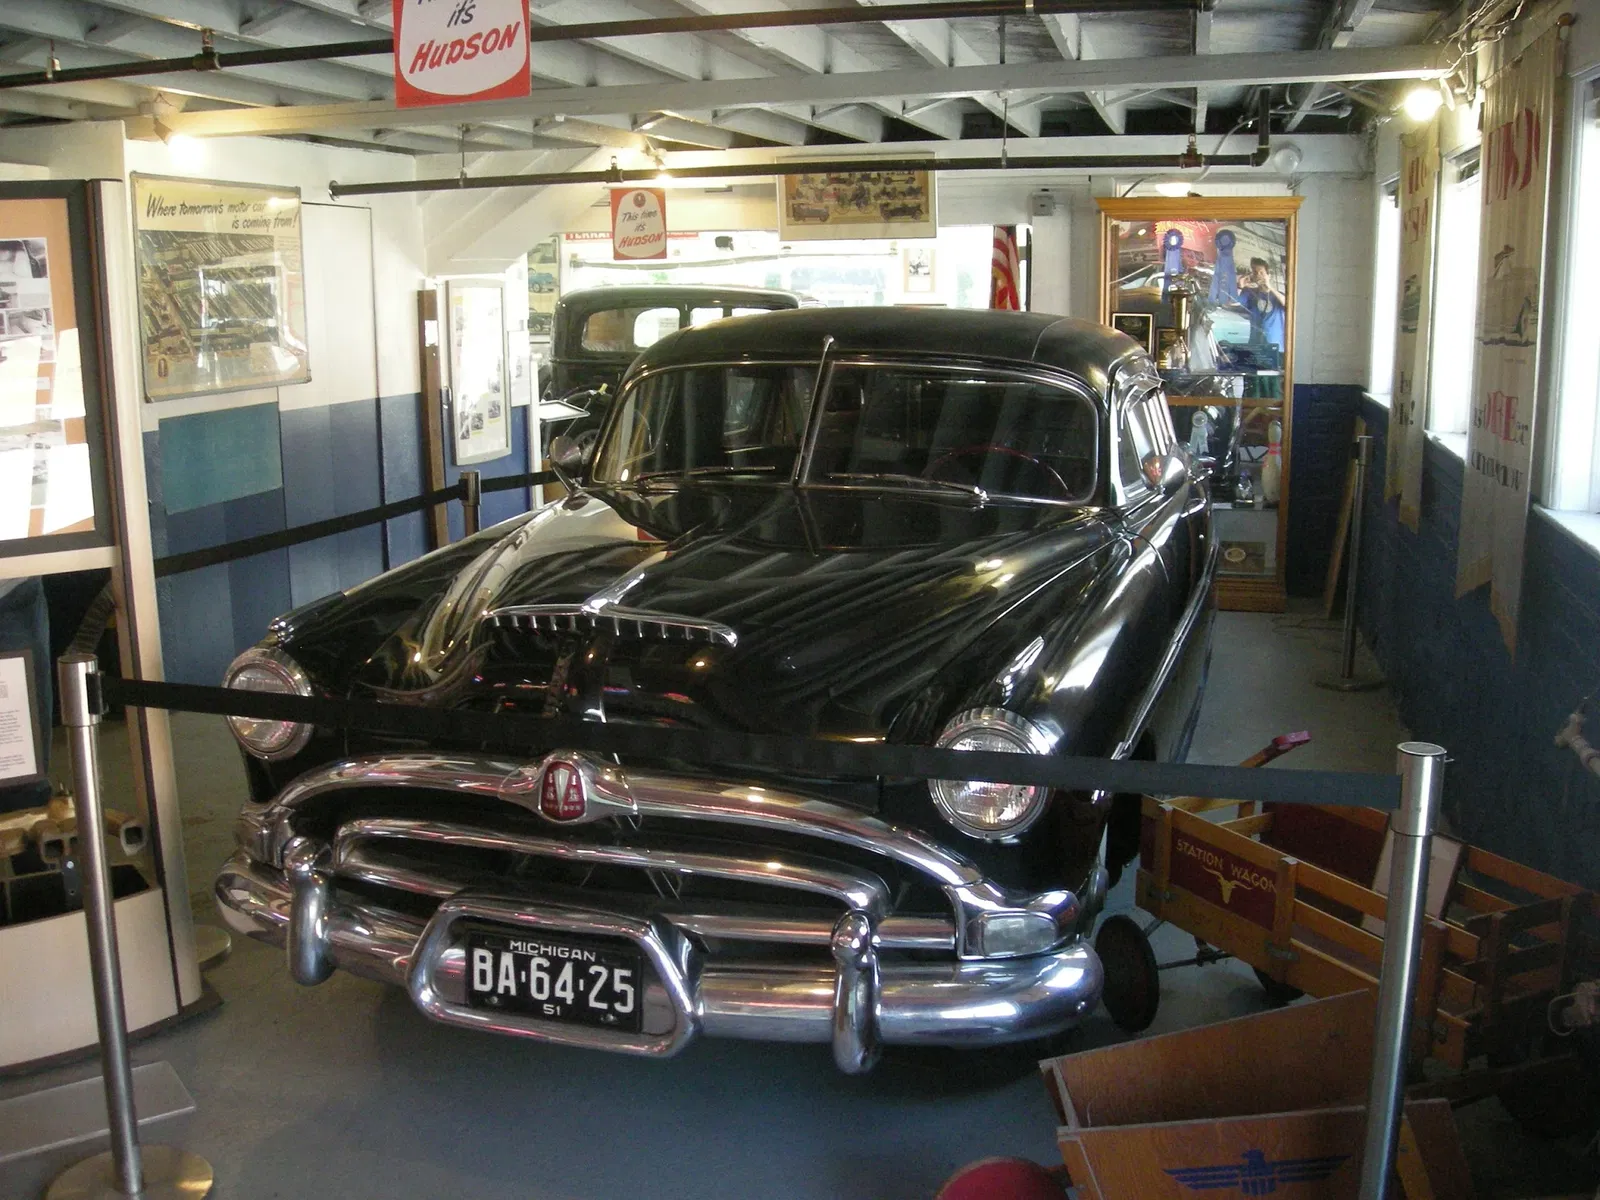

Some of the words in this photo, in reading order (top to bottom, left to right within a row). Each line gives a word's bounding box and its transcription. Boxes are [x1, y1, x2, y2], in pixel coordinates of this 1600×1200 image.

[409, 21, 521, 74] HUDSON
[146, 193, 177, 218] Where
[179, 199, 224, 217] tomorrow's
[227, 200, 251, 214] motor
[622, 212, 638, 222] This
[640, 209, 658, 220] time
[232, 216, 240, 229] is
[242, 216, 271, 232] coming
[273, 207, 299, 230] from!
[618, 232, 665, 248] HUDSON
[1176, 838, 1225, 871] STATION
[1231, 863, 1278, 893] WAGON
[509, 940, 597, 963] MICHIGAN
[543, 1003, 561, 1016] 51
